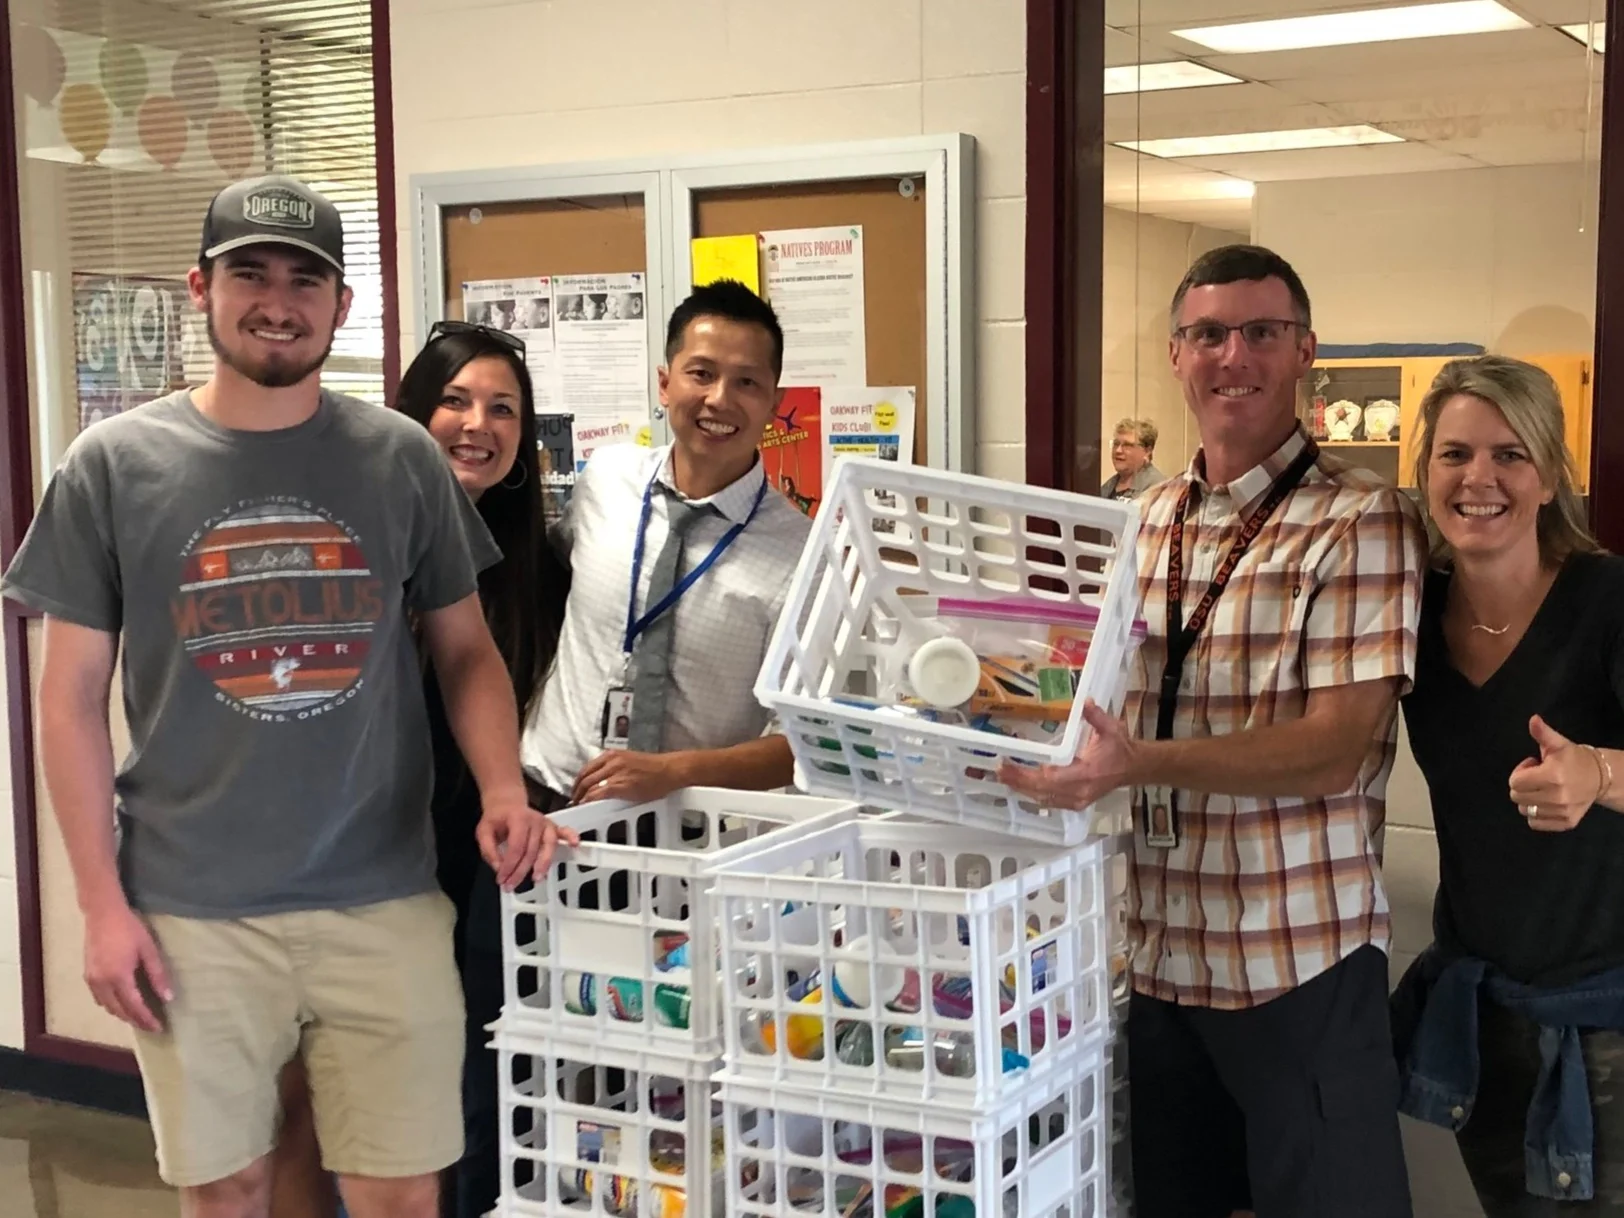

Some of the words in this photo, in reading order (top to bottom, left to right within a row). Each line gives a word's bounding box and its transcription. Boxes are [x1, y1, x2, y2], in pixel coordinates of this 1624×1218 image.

[251, 196, 308, 222] OREGON
[781, 242, 813, 258] NATIVES
[814, 240, 853, 257] PROGRAM
[830, 405, 859, 415] OAKWAY
[861, 404, 873, 415] FIT
[577, 426, 609, 441] OAKWAY
[831, 422, 848, 432] KIDS
[763, 437, 781, 449] ARTS
[781, 431, 809, 444] CENTER
[1168, 523, 1183, 602] BEAVERS
[1189, 595, 1213, 630] OSU
[1216, 508, 1269, 586] BEAVERS
[170, 578, 384, 638] METOLIUS
[219, 644, 349, 665] RIVER
